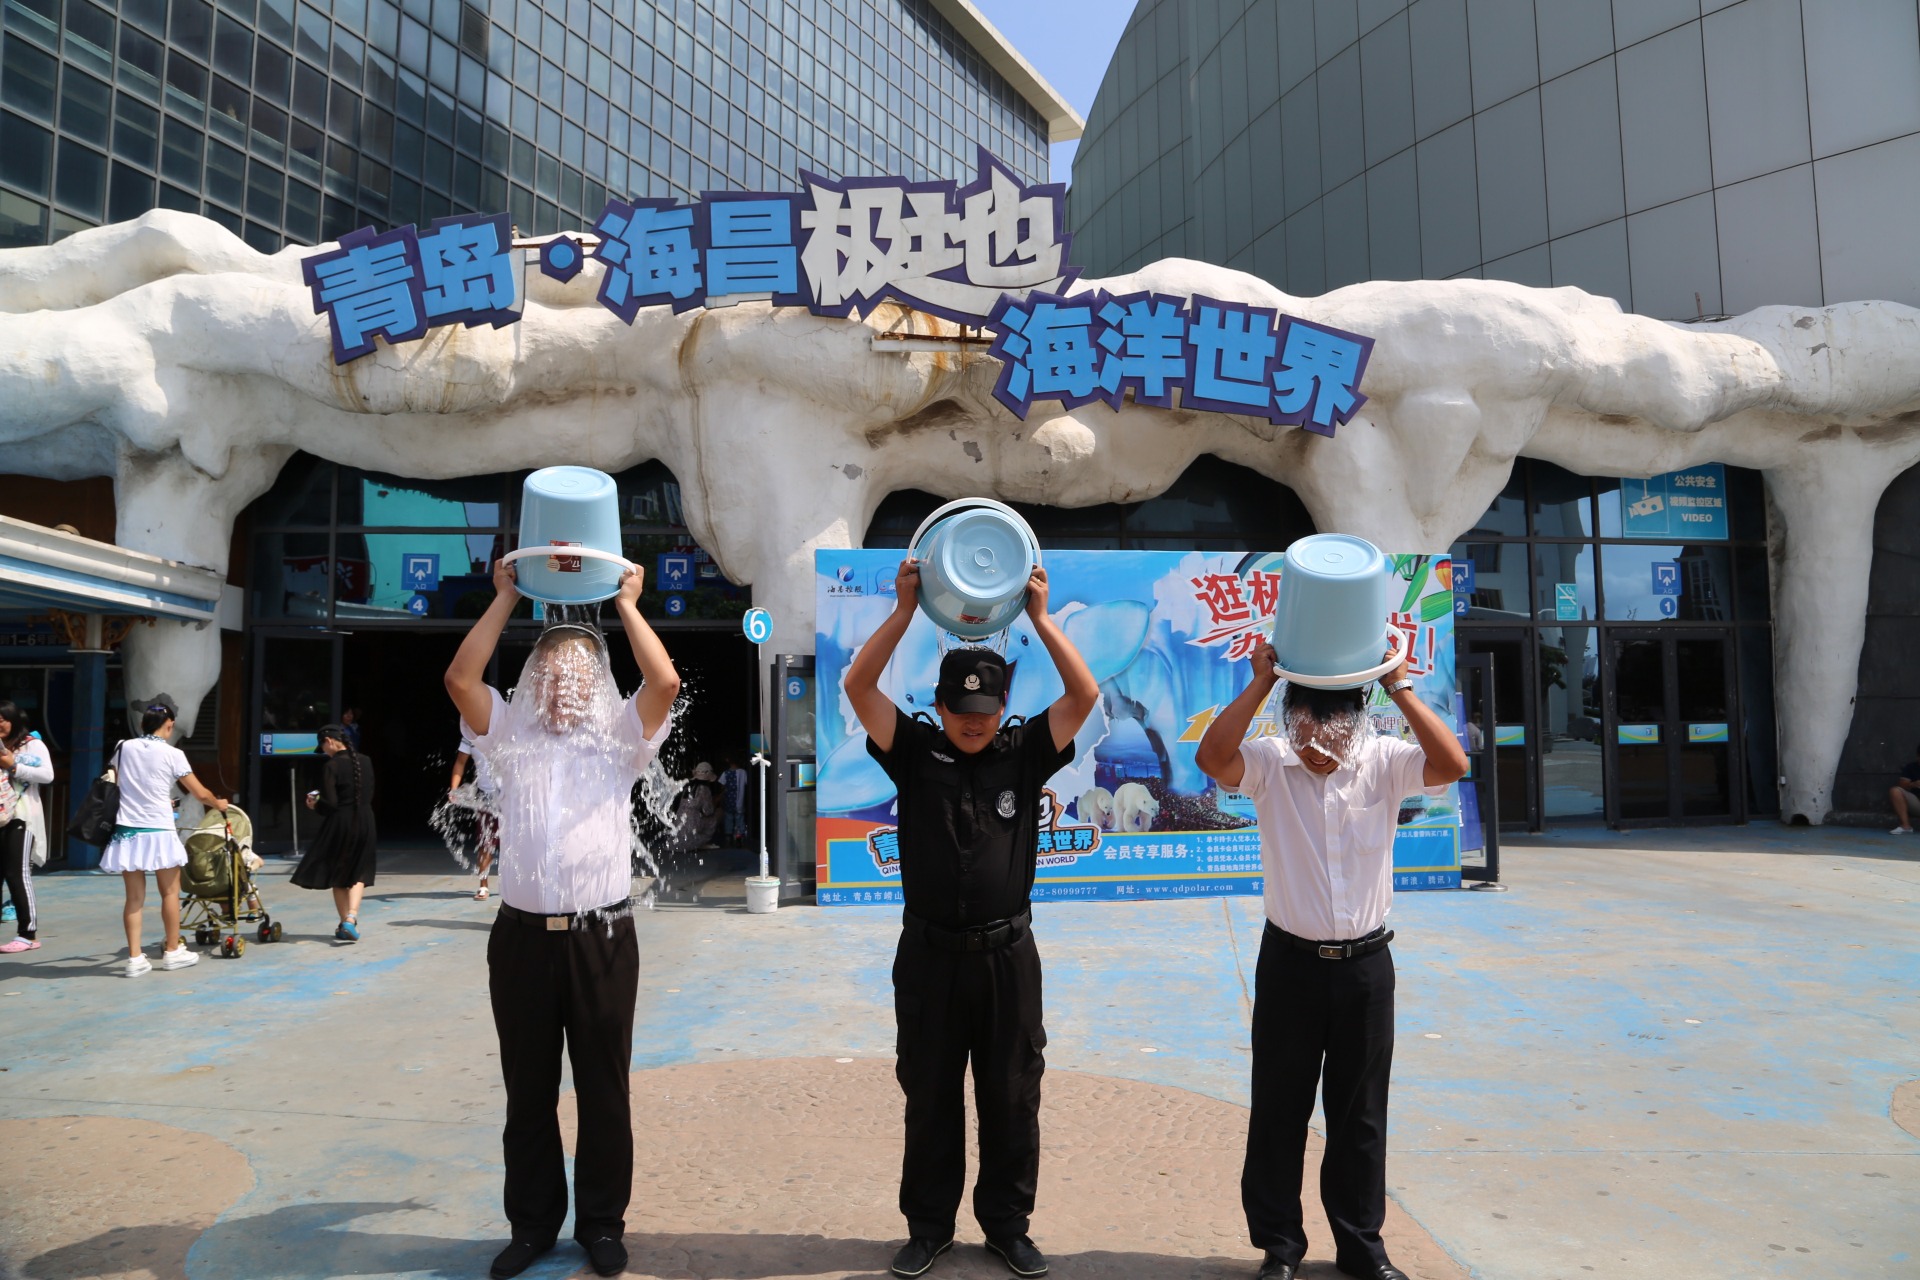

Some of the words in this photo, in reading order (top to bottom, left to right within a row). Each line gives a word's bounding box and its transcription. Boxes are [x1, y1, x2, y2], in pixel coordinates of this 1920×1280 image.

[1001, 300, 1362, 426] 海洋世界
[1674, 475, 1716, 488] 公共安全
[1681, 513, 1713, 522] VIDEO
[412, 599, 424, 612] 4
[670, 600, 681, 612] 3
[1456, 601, 1465, 613] 2
[1664, 602, 1671, 612] 1
[750, 610, 766, 640] 6
[788, 681, 801, 695] 6
[1103, 843, 1194, 861] 会员专享服务：
[1046, 855, 1075, 865] WORLD
[882, 865, 901, 875] QIN
